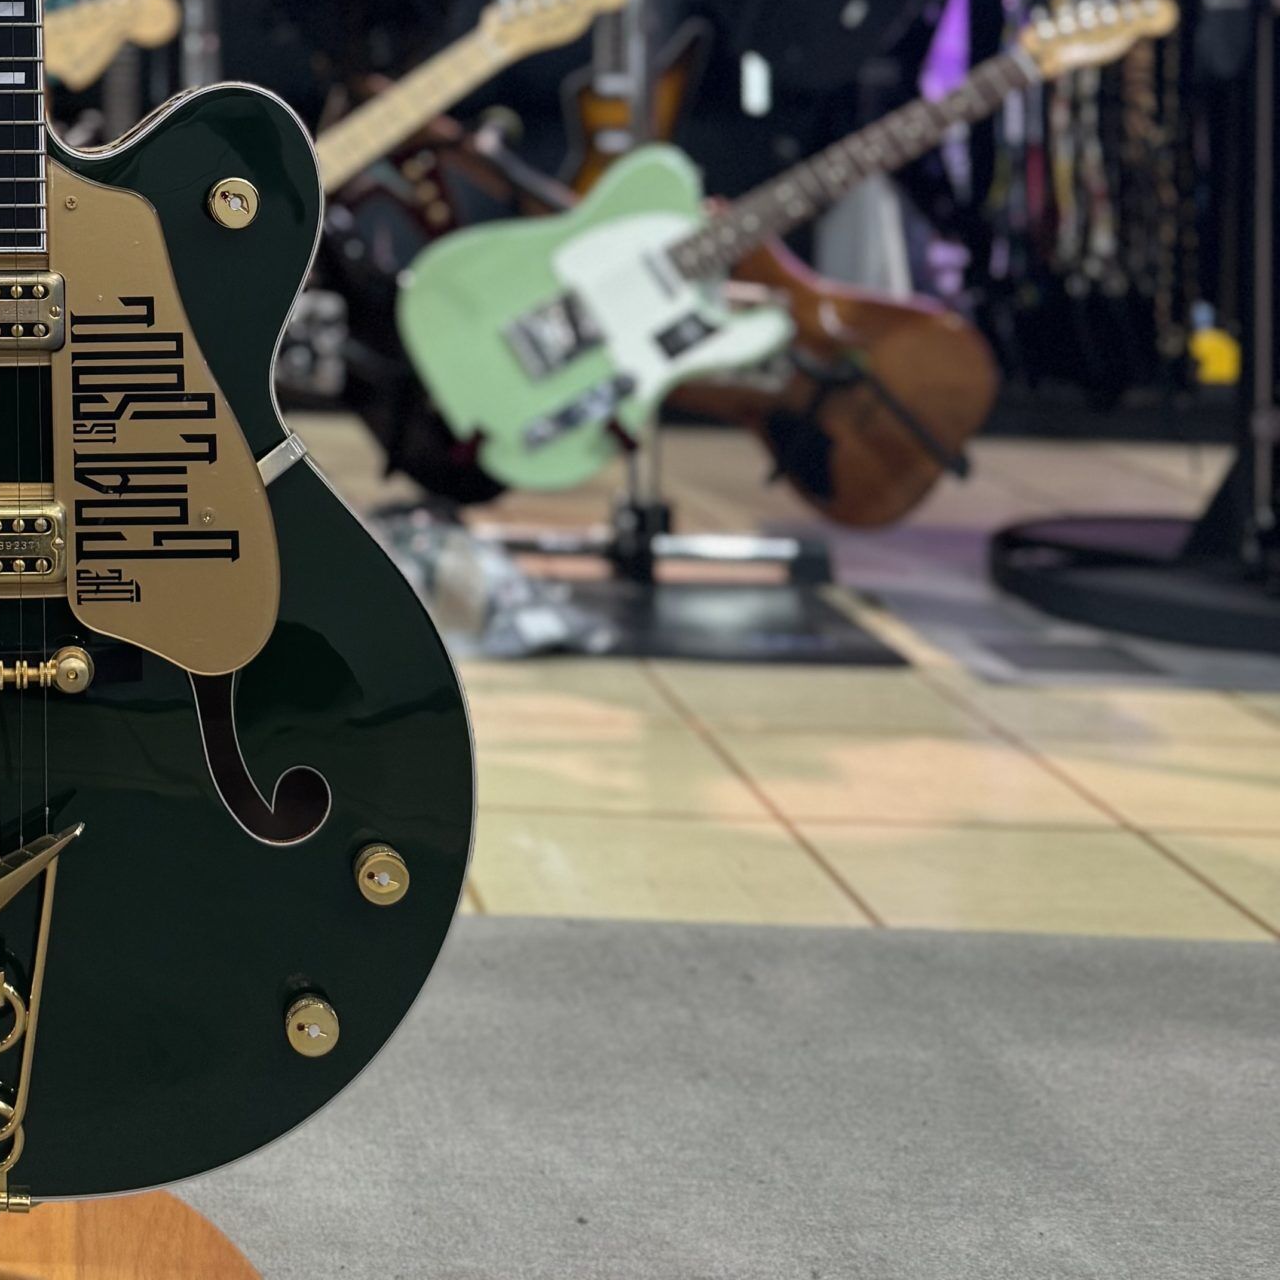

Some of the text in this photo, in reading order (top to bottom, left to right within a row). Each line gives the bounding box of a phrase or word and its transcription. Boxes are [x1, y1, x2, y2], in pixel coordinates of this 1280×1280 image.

[70, 296, 240, 606] THE GOAL IS SOUL
